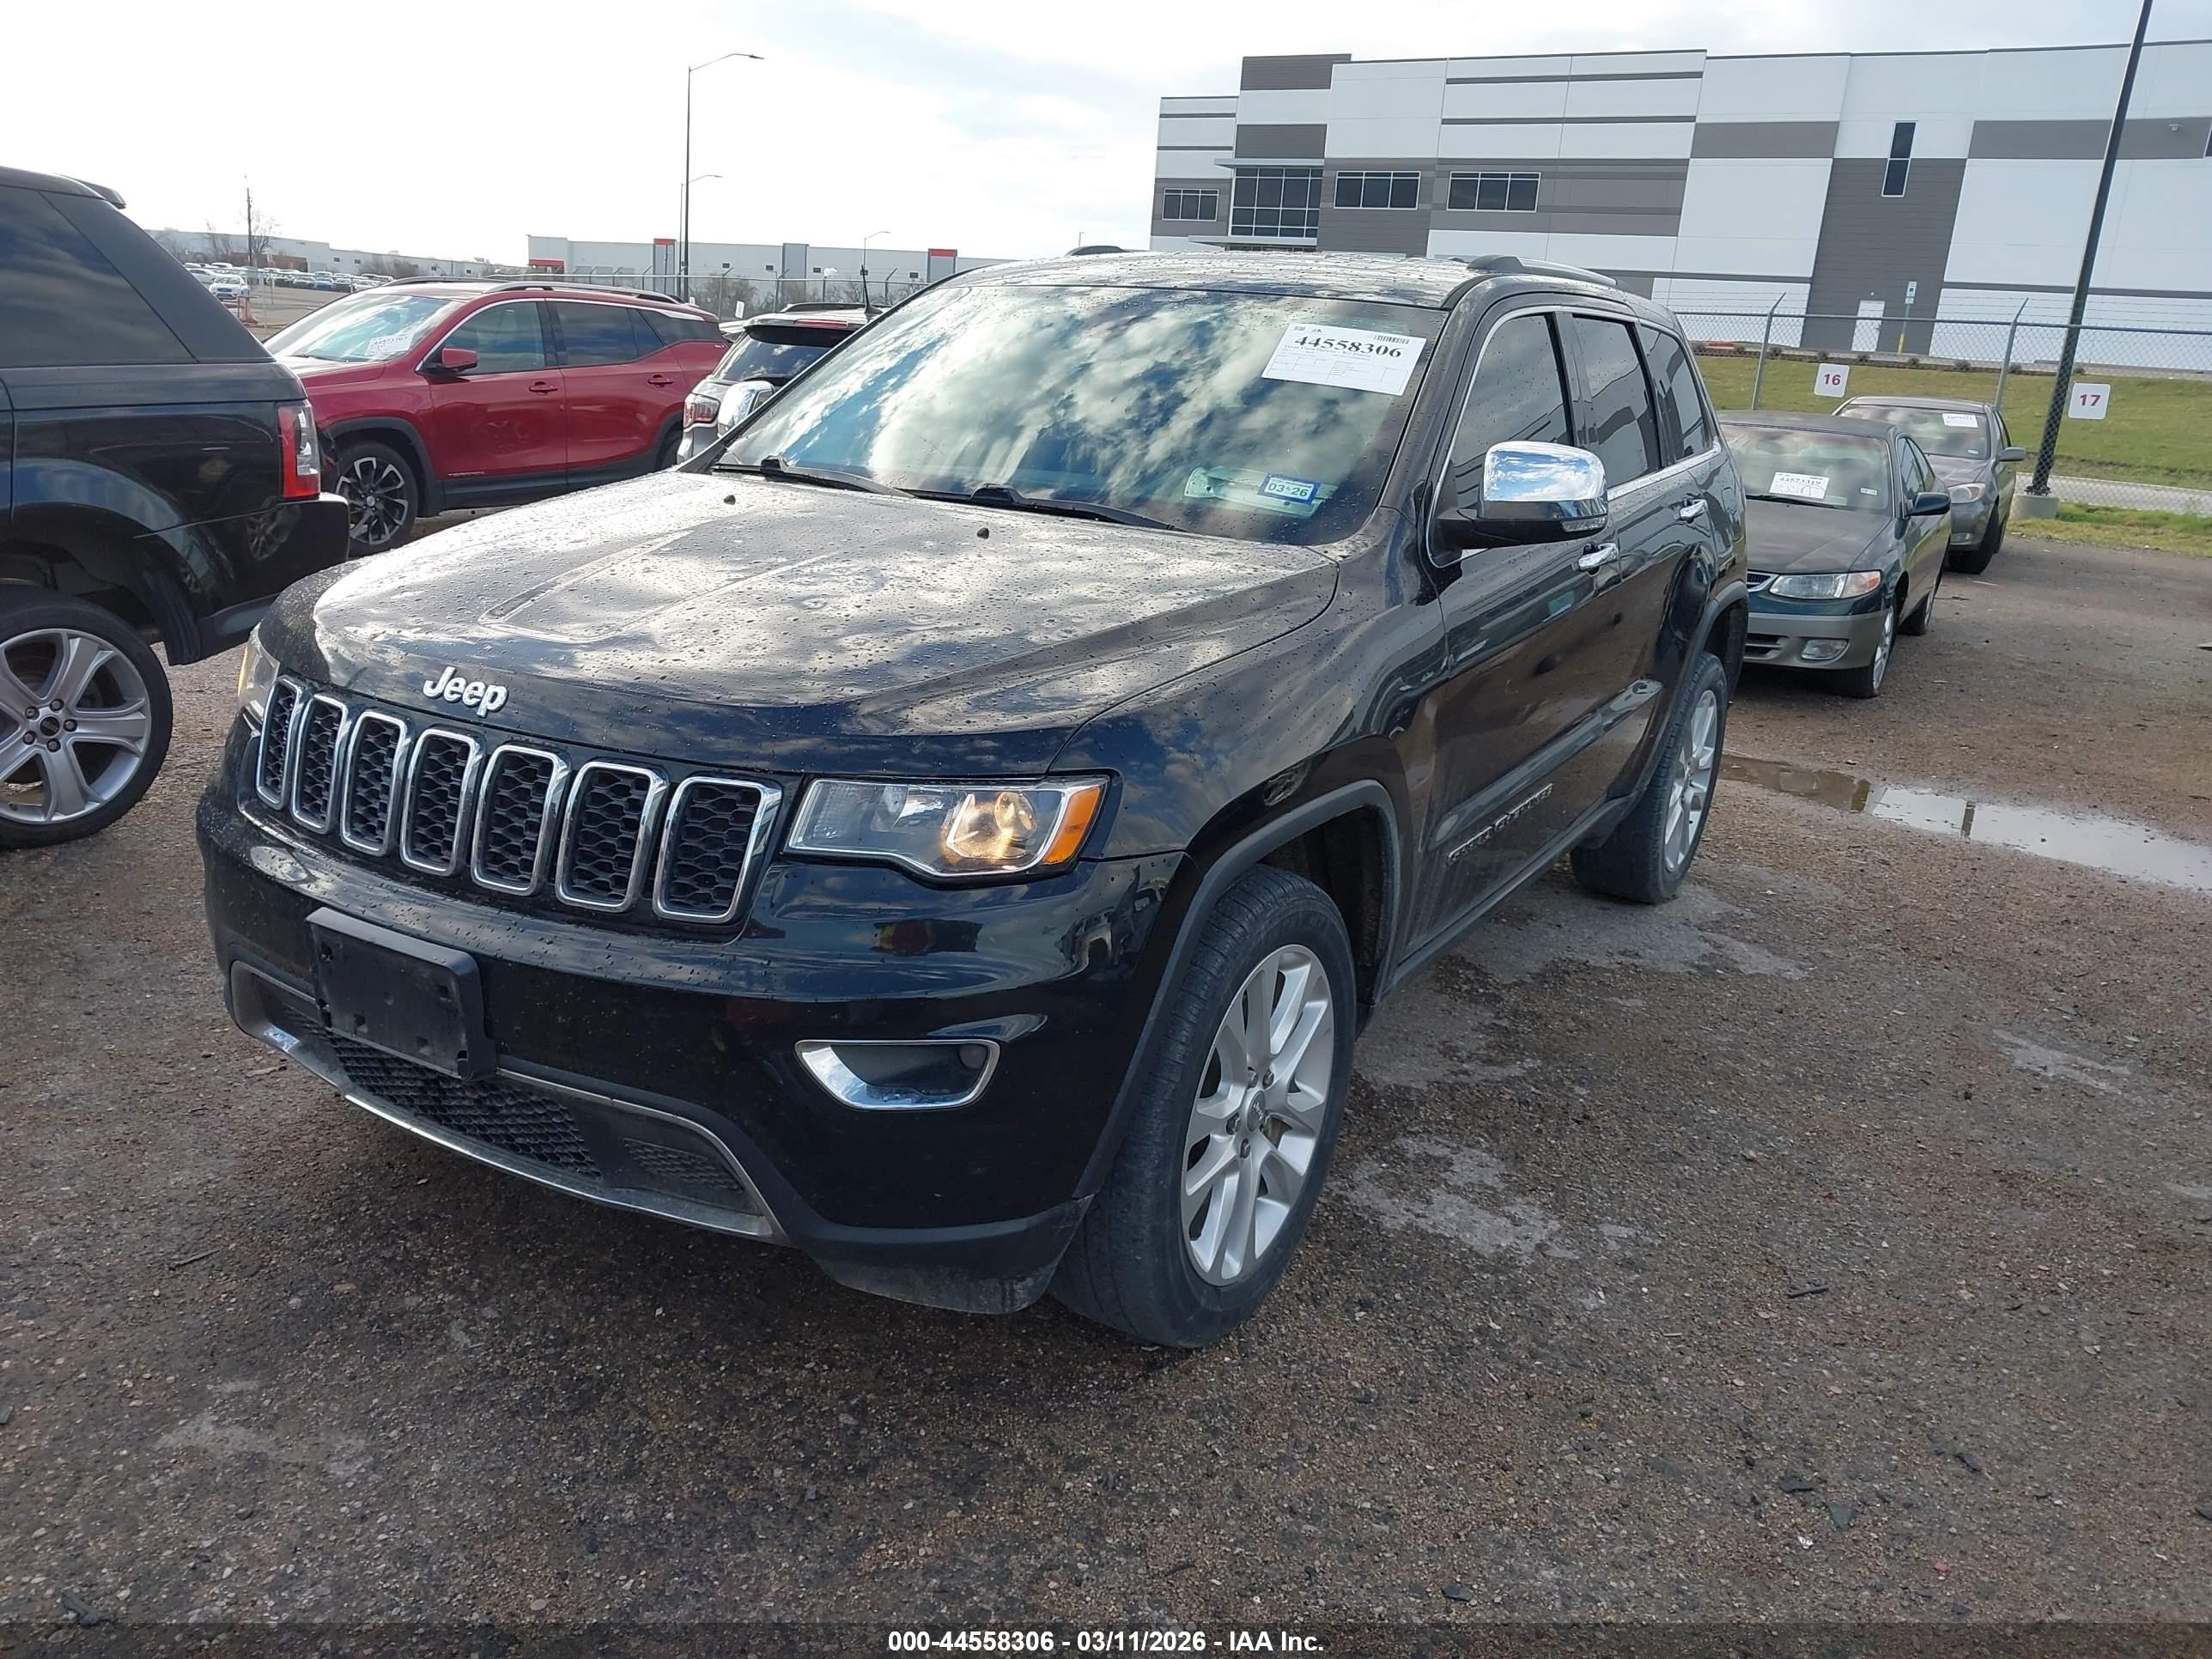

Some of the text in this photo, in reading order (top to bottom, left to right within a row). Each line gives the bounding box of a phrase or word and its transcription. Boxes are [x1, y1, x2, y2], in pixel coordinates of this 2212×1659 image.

[1294, 336, 1402, 357] 44558306
[1823, 373, 1842, 386] 16
[2079, 393, 2101, 407] 17
[422, 666, 508, 718] Jeep
